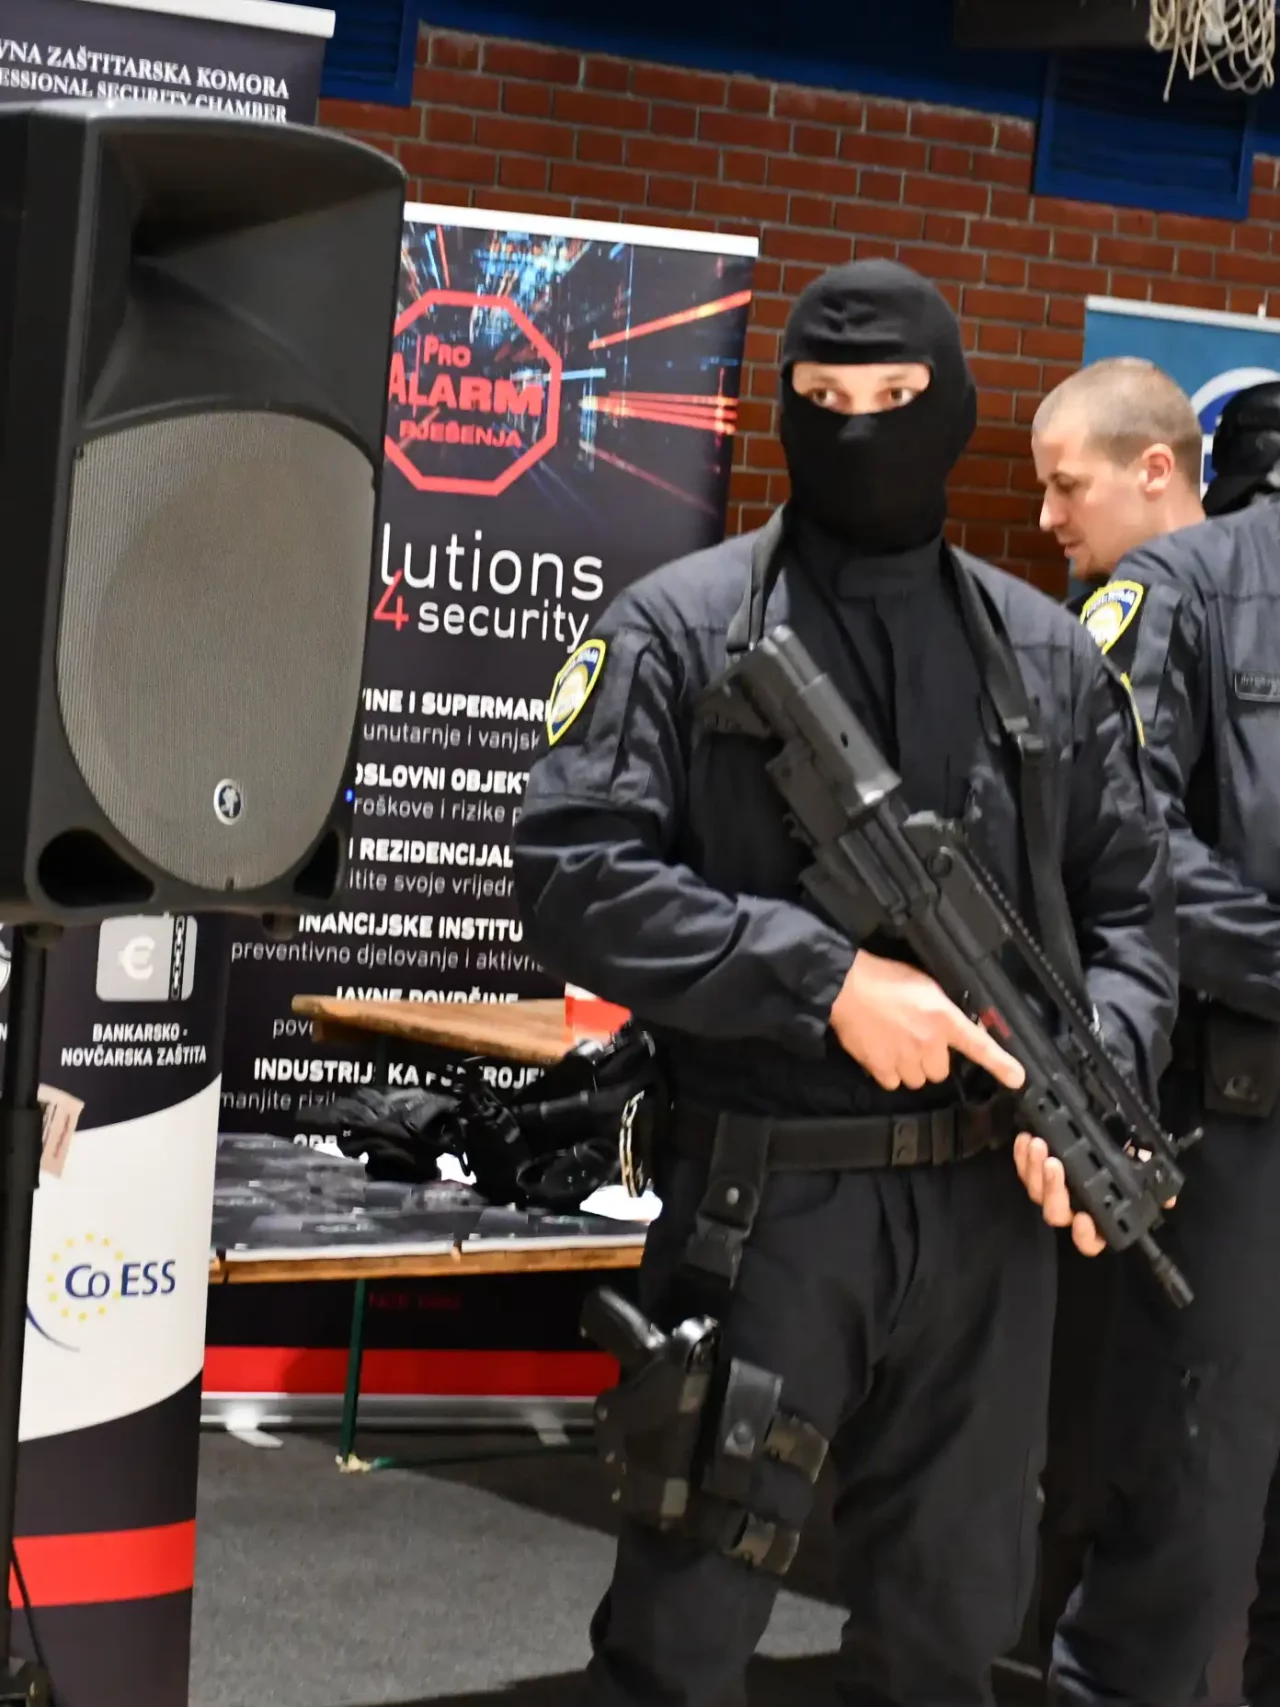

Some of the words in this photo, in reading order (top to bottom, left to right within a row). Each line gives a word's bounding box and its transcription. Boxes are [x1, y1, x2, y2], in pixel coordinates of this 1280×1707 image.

[47, 45, 192, 86] ZAŠTITARSKA
[197, 66, 290, 100] KOMORA
[195, 94, 287, 123] CHAMBER
[389, 352, 545, 416] ALARM
[380, 523, 604, 600] lutions
[373, 569, 409, 631] 4
[418, 599, 590, 654] security
[363, 687, 403, 713] INE
[409, 690, 416, 714] I
[364, 722, 461, 750] unutarnje
[468, 725, 472, 747] i
[441, 798, 445, 819] i
[452, 799, 505, 823] rizike
[394, 871, 446, 898] svoje
[438, 916, 523, 942] INSTITU
[231, 940, 350, 963] preventivno
[357, 944, 458, 973] djelovanje
[465, 948, 469, 969] i
[93, 1024, 179, 1042] BANKARSKO
[61, 1044, 152, 1067] NOVČARSKA
[157, 1043, 207, 1064] ZAŠTITA
